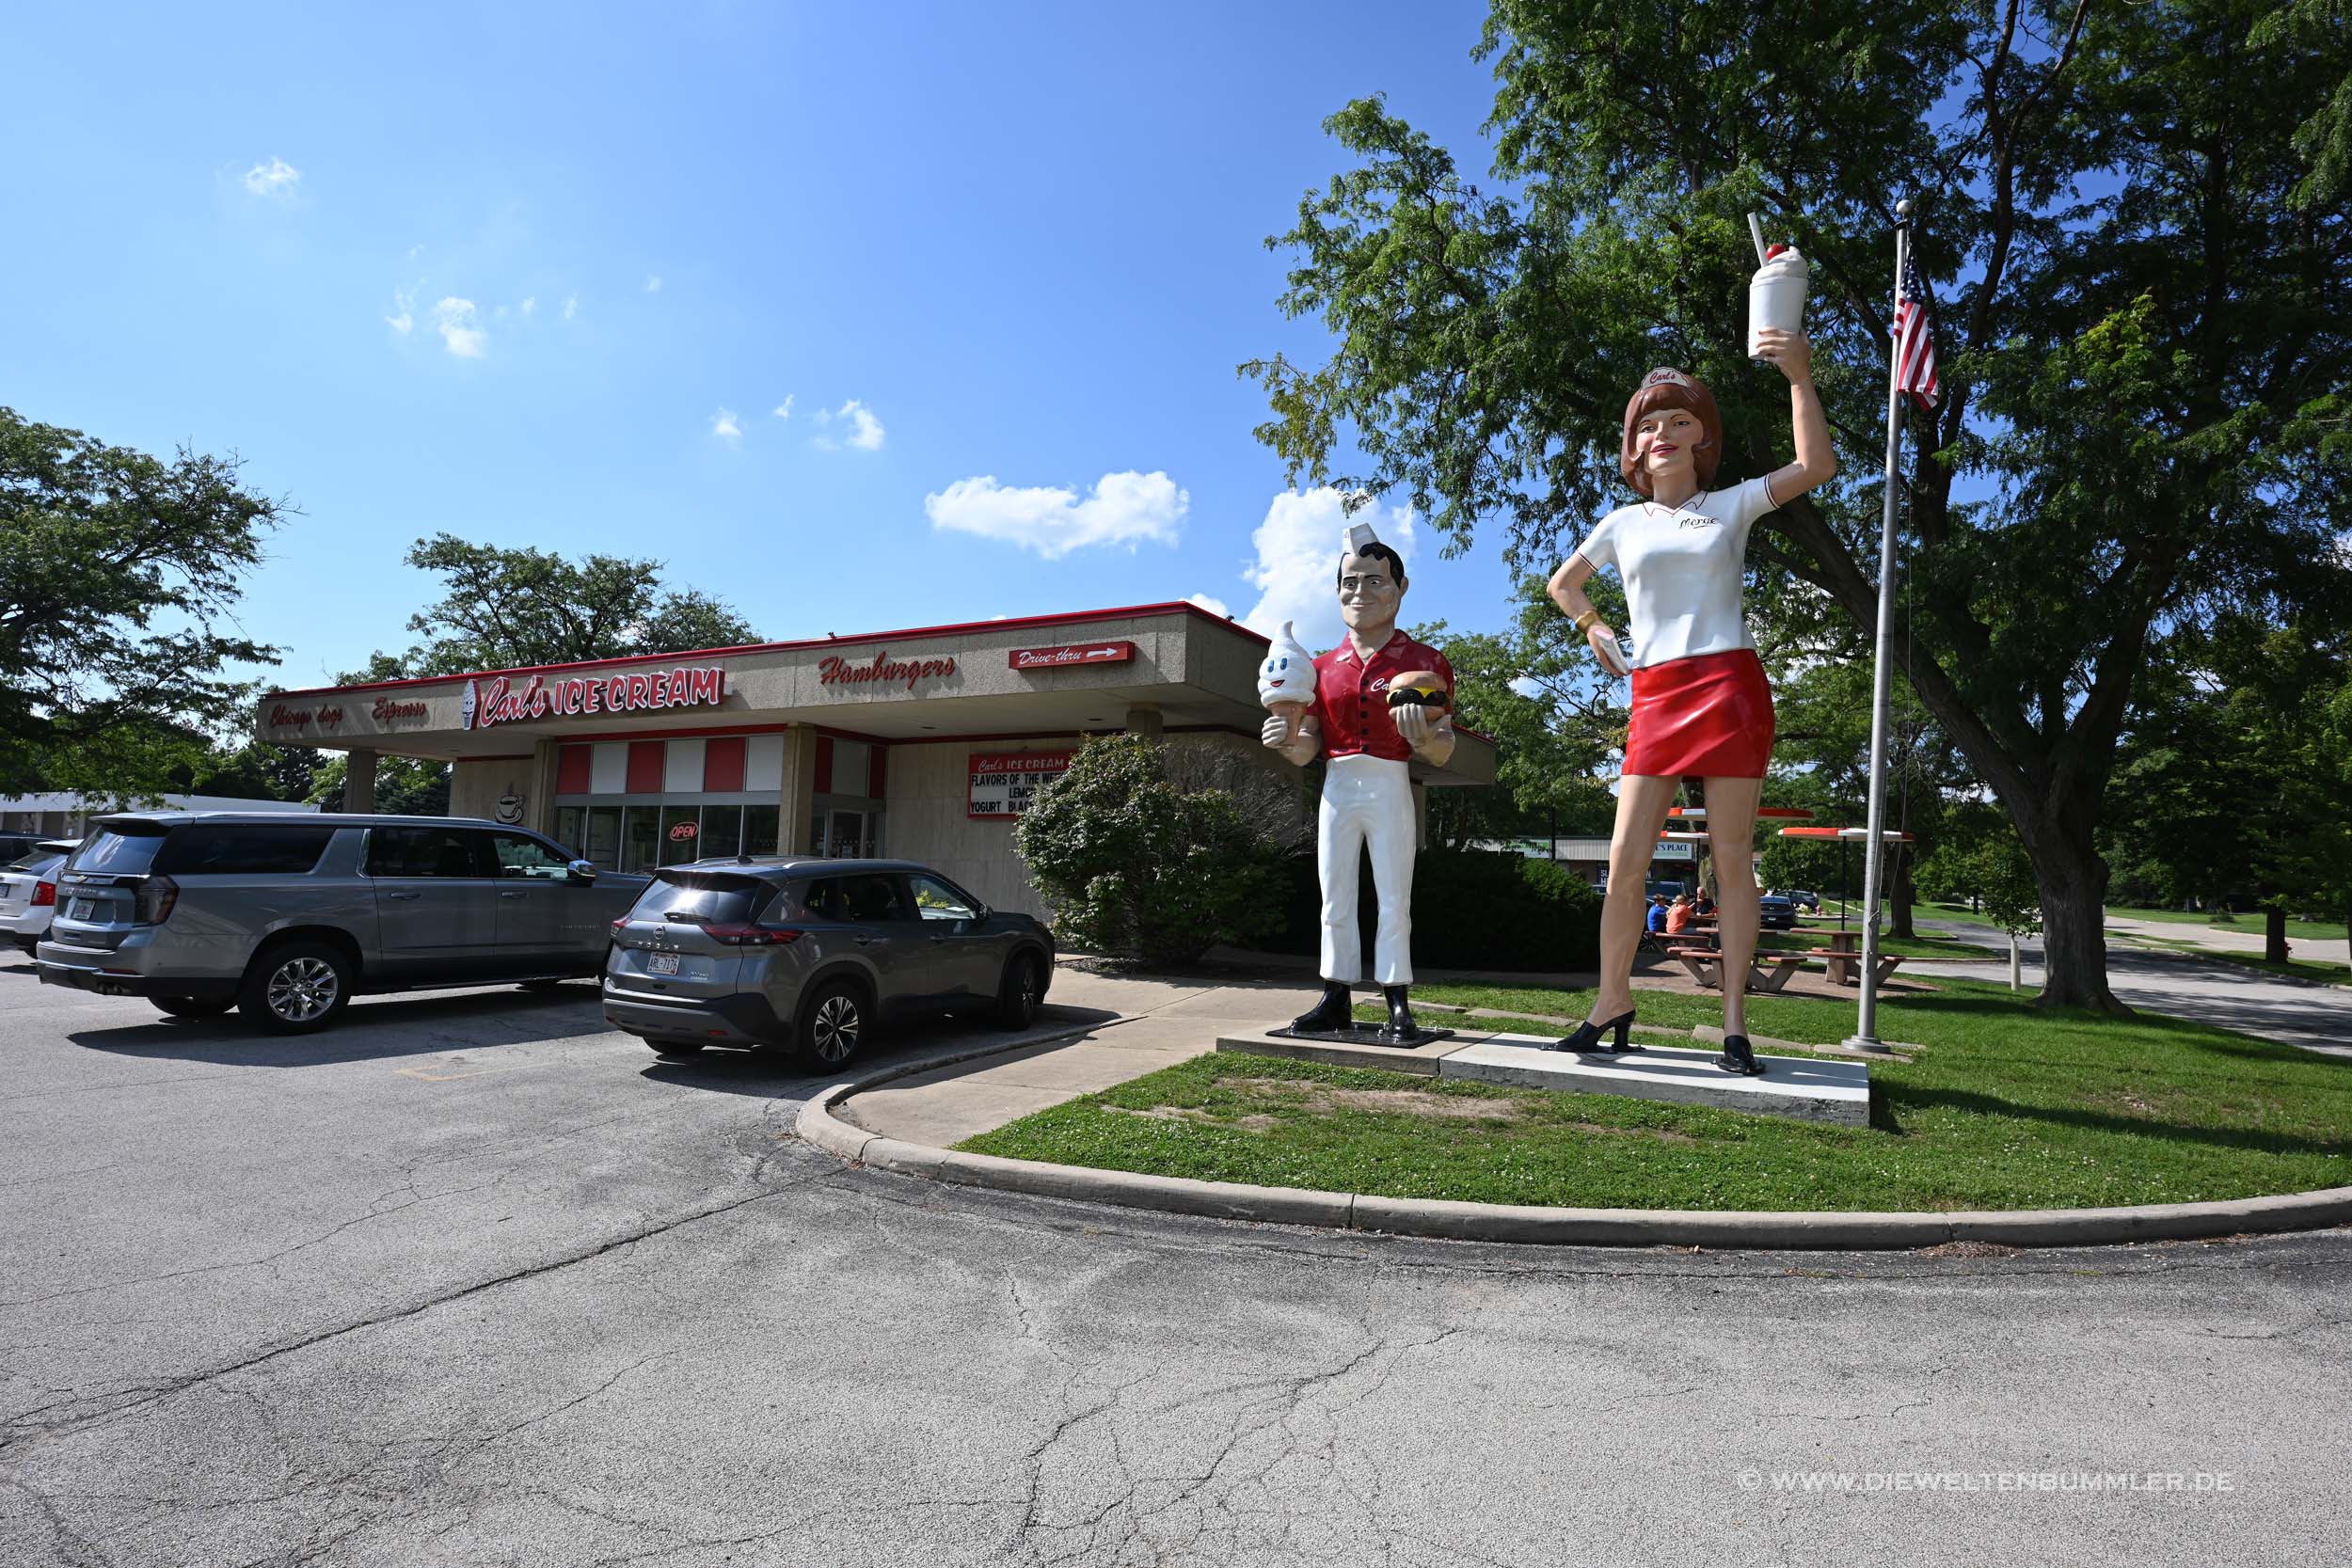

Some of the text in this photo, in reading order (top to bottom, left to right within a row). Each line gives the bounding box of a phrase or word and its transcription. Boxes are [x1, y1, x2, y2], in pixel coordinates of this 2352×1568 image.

[1649, 371, 1676, 384] Carl's
[1019, 647, 1082, 665] Drive-thru
[818, 651, 956, 689] Hamburgers
[1370, 677, 1390, 692] Ca
[479, 668, 723, 728] Carl's ICE CREAM
[372, 696, 427, 724] Espresso
[269, 704, 343, 732] Chicago dogs
[978, 757, 1064, 772] Carl's ICE CREAM
[971, 771, 1061, 787] FLAVORS OF THE WE
[1009, 786, 1034, 799] LEMO
[970, 800, 1033, 814] YOGURT BLAC
[672, 825, 695, 839] OPEN
[1667, 843, 1689, 852] PLACE
